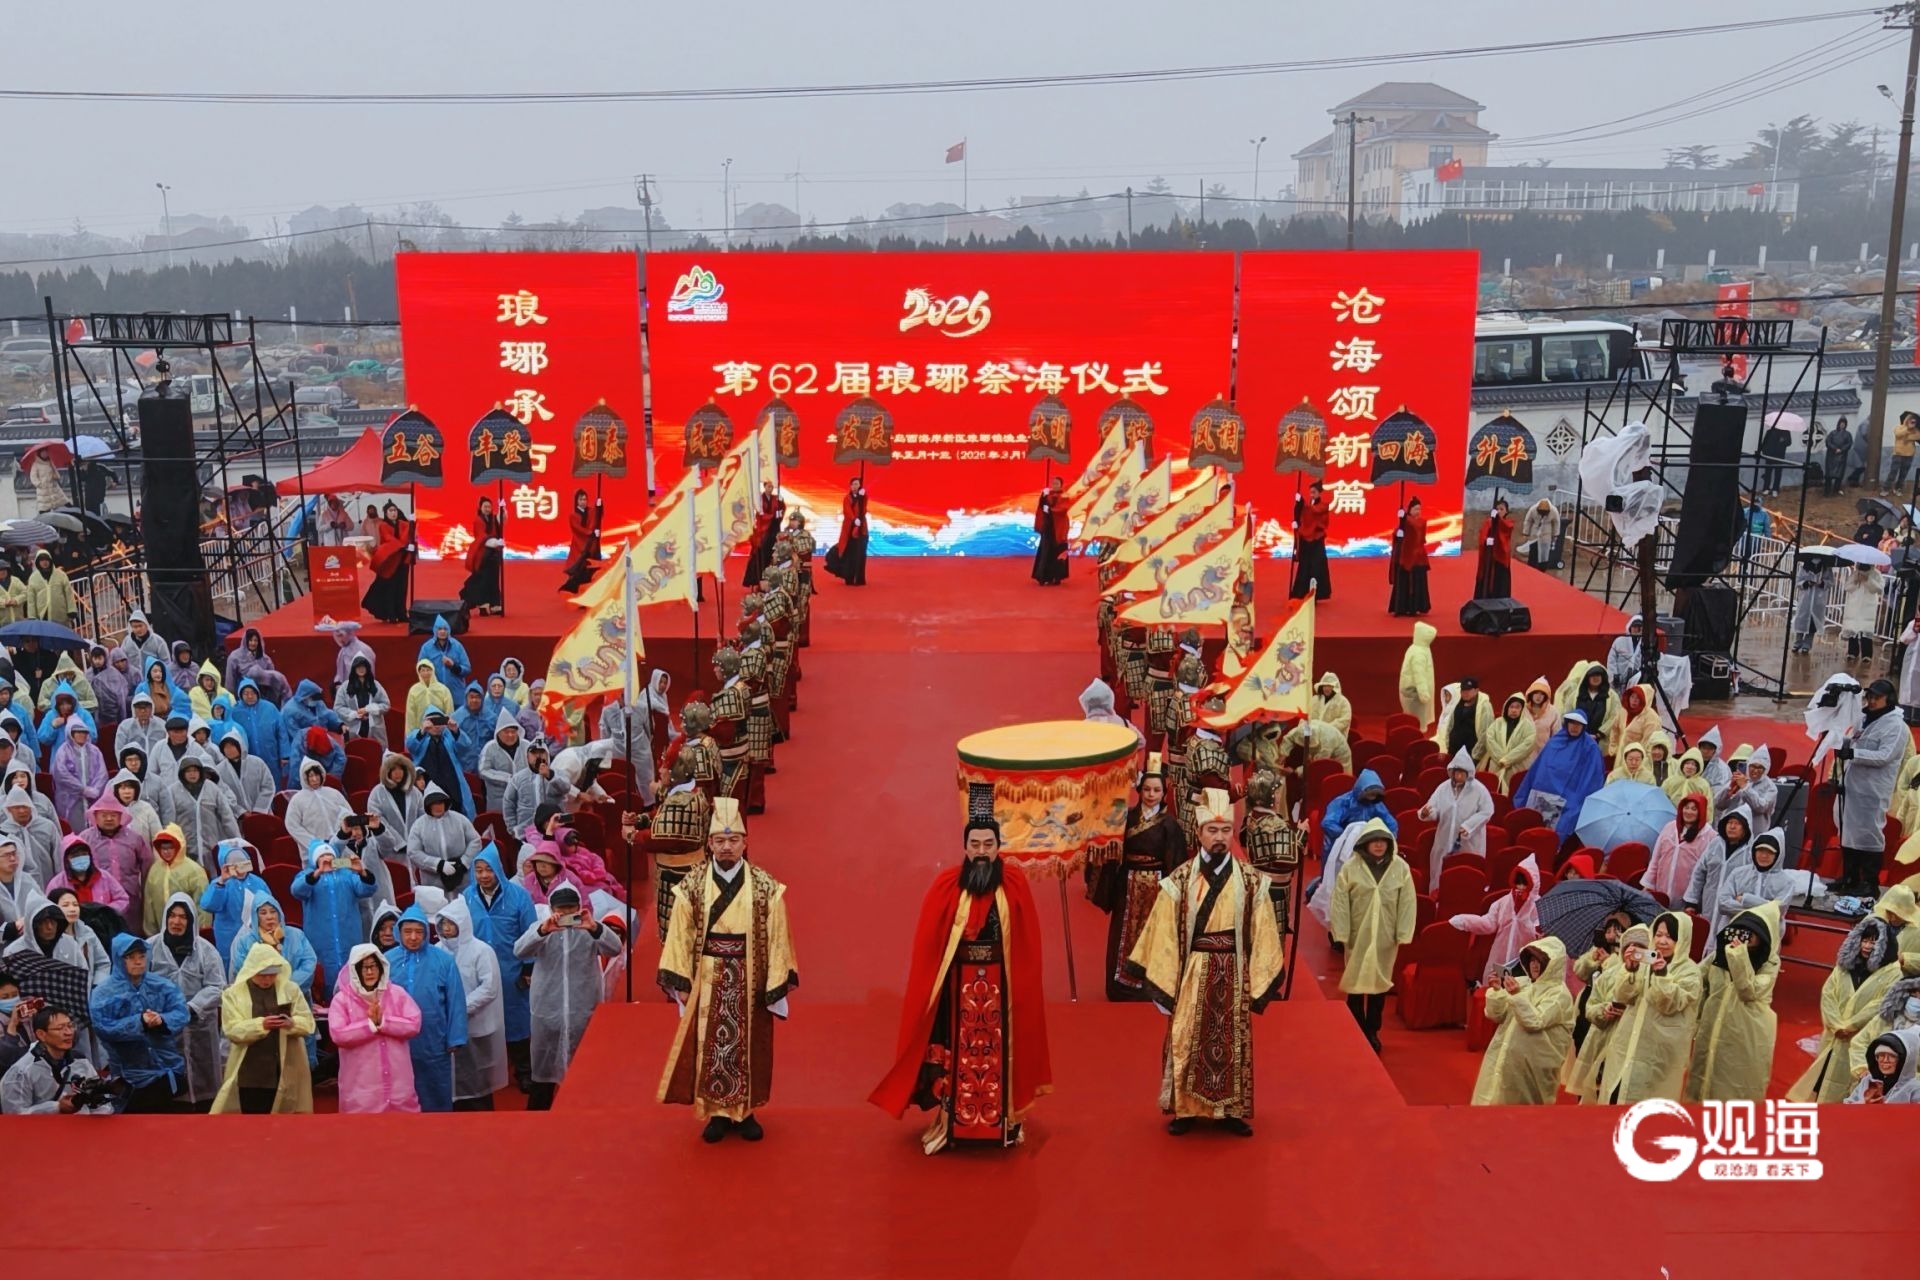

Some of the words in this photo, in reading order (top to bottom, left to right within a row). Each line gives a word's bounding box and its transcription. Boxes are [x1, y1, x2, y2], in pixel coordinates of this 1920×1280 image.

[900, 288, 991, 337] 2026
[713, 361, 1168, 396] 第62届琅琊祭海仪式
[1322, 287, 1385, 515] 沧海颂新篇
[387, 432, 439, 466] 五谷
[474, 428, 527, 468] 丰登
[579, 421, 623, 464] 国泰
[1193, 416, 1239, 455] 风调
[1378, 430, 1429, 467] 四海
[1476, 433, 1529, 477] 升平
